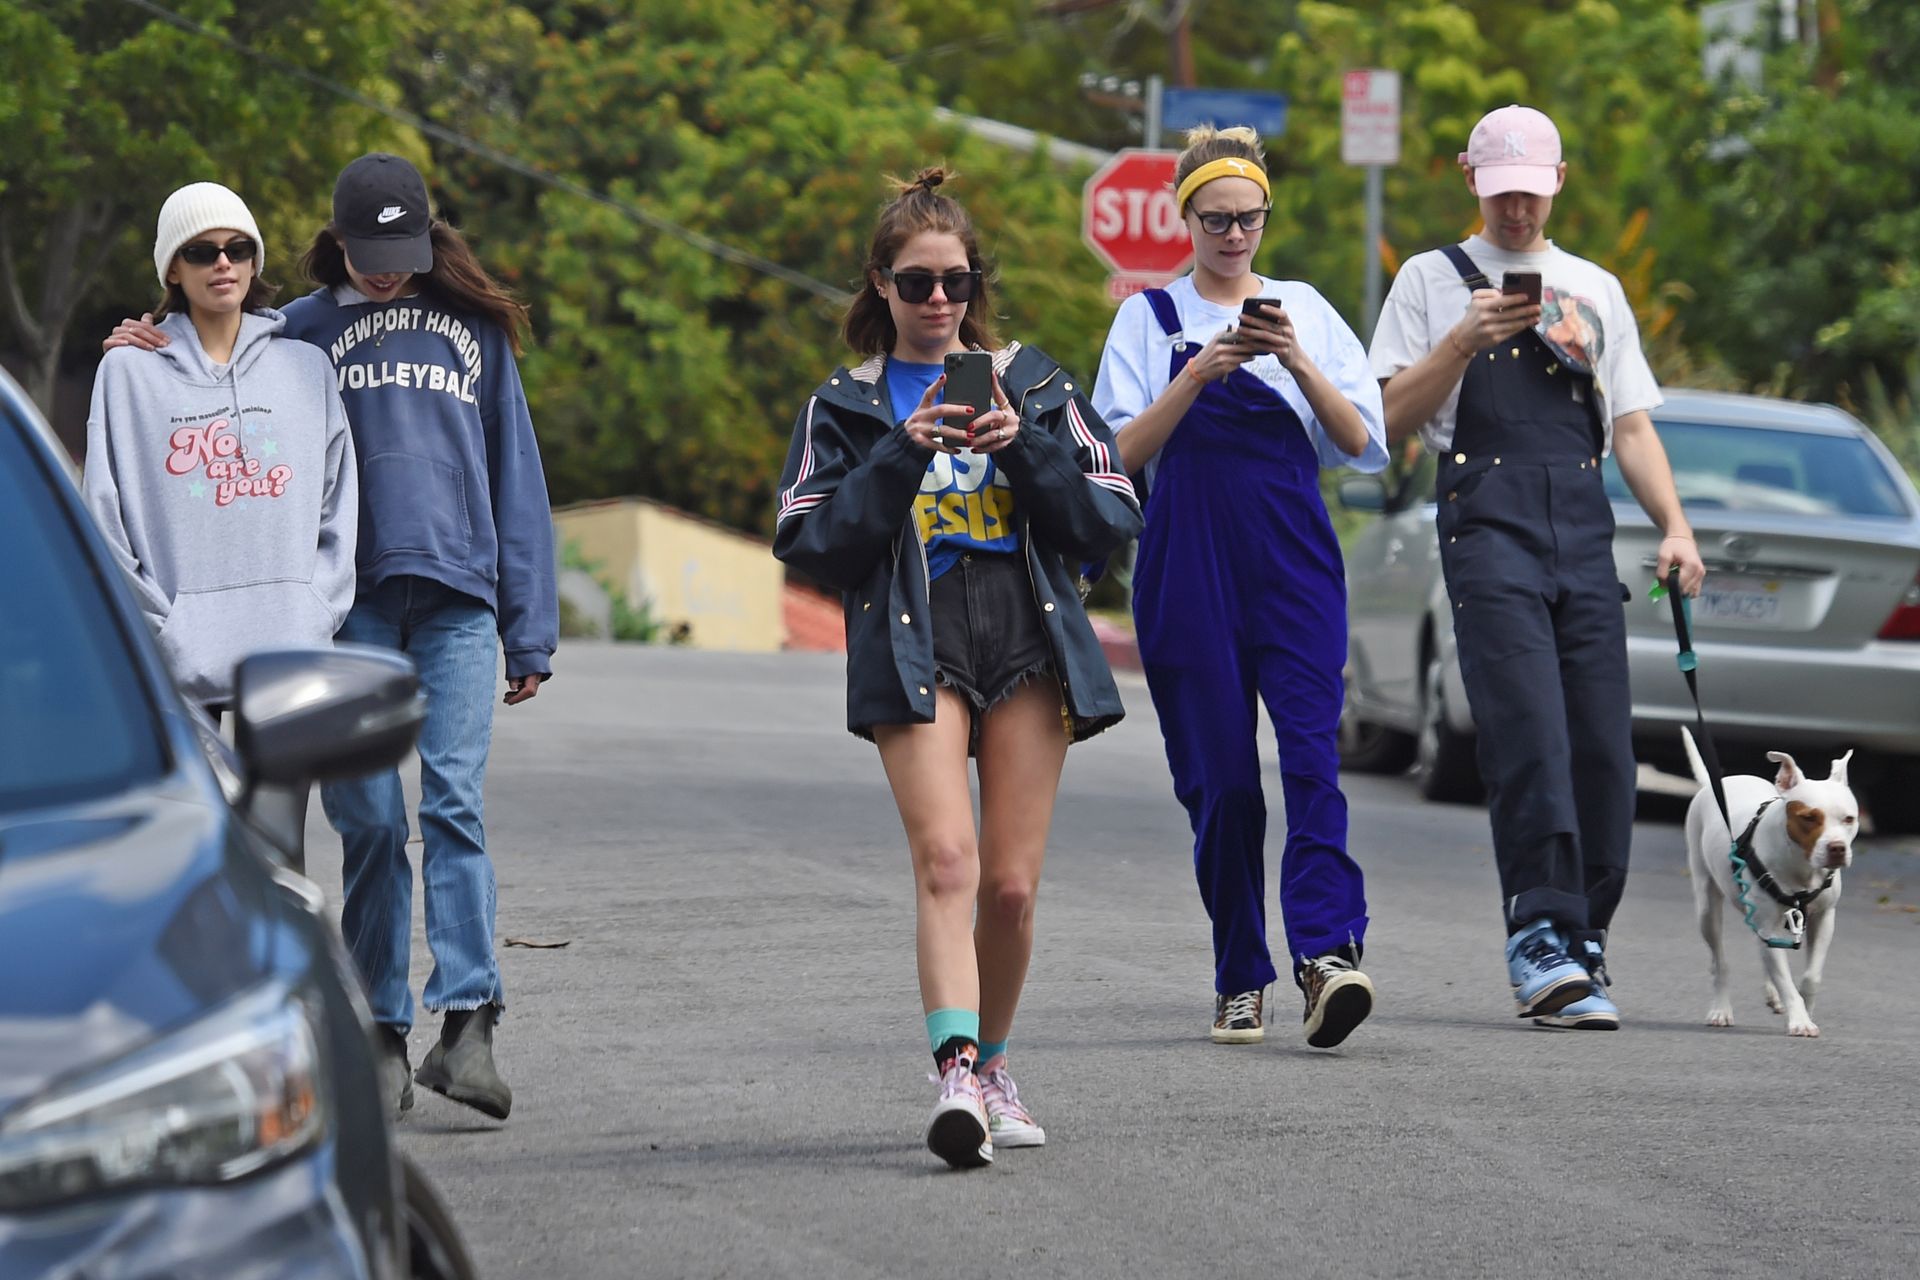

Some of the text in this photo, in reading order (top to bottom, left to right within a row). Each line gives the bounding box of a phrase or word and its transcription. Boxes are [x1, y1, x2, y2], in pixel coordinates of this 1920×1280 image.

[382, 206, 401, 217] NIKE
[1094, 188, 1188, 242] STO
[331, 308, 421, 364] NEWPORT
[338, 361, 479, 406] VOLLEYBAL
[206, 458, 260, 480] are
[215, 465, 292, 506] you?
